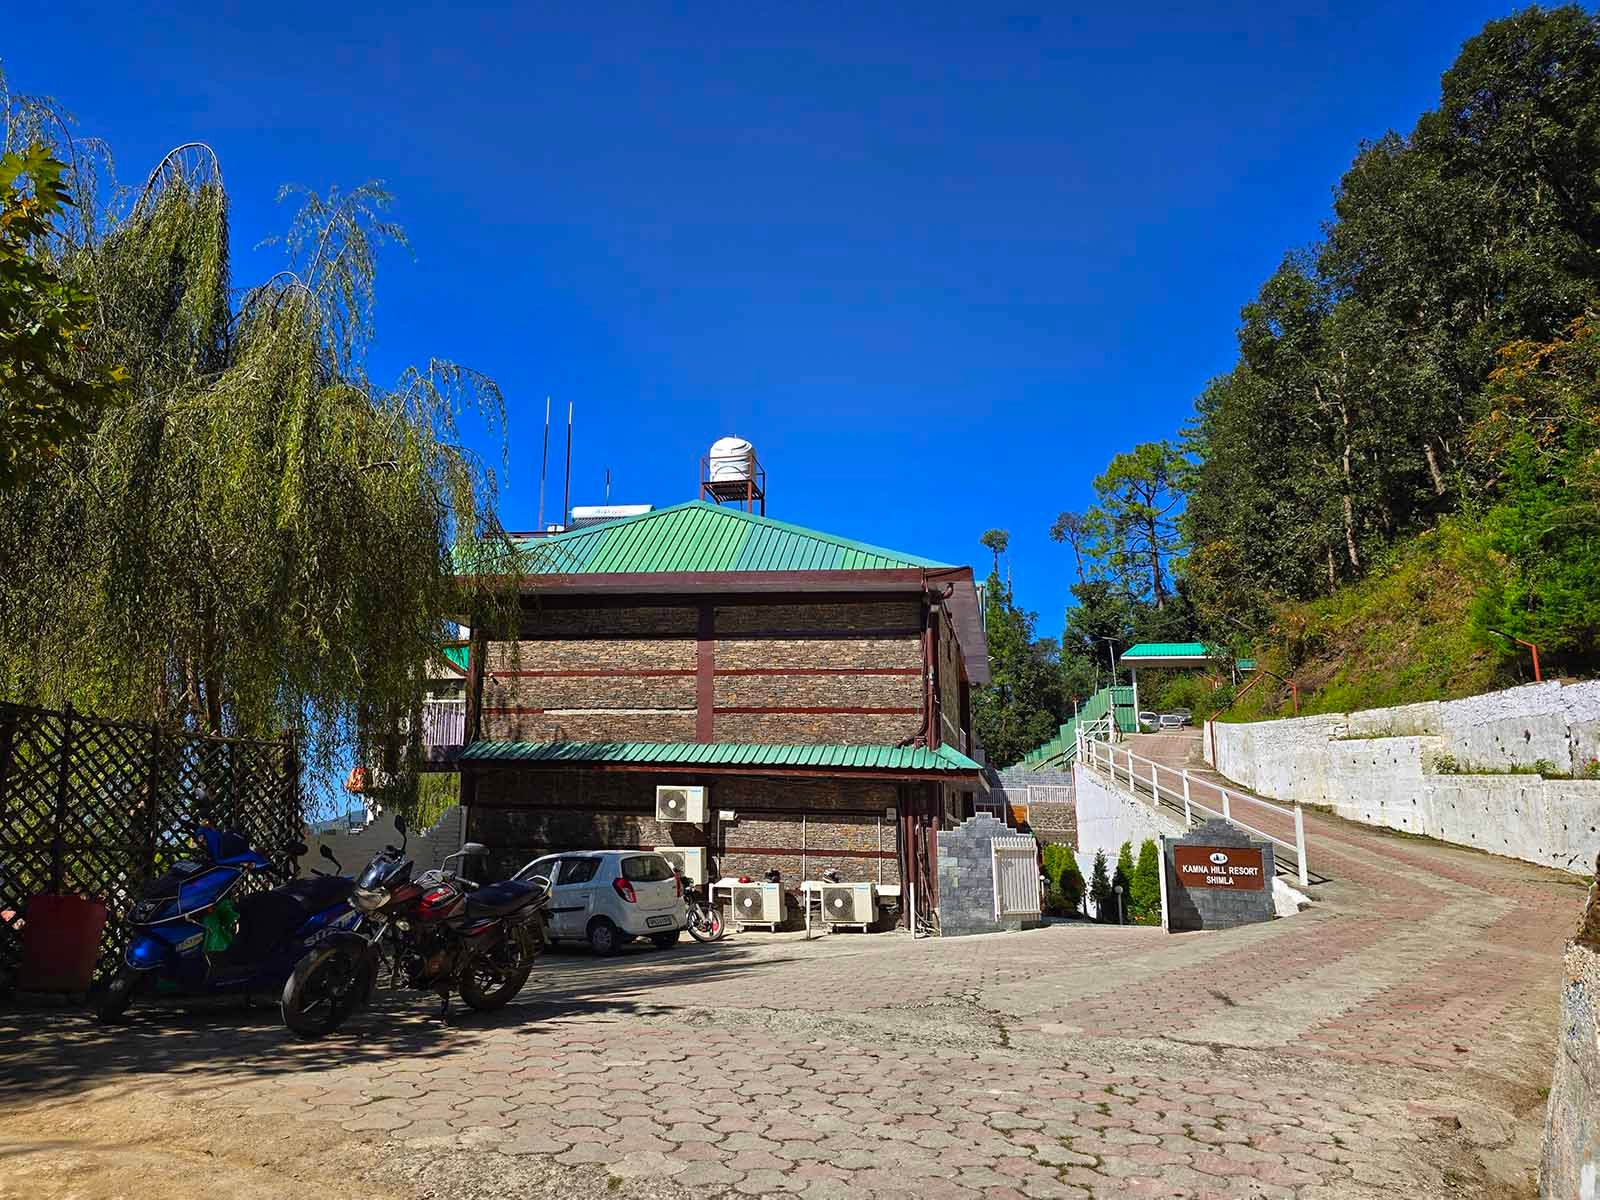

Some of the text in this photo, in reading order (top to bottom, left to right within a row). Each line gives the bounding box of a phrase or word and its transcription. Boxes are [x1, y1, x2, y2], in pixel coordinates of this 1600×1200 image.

[1182, 865, 1259, 876] KAMNA HILL RESORT
[1206, 876, 1234, 885] SHIMLA
